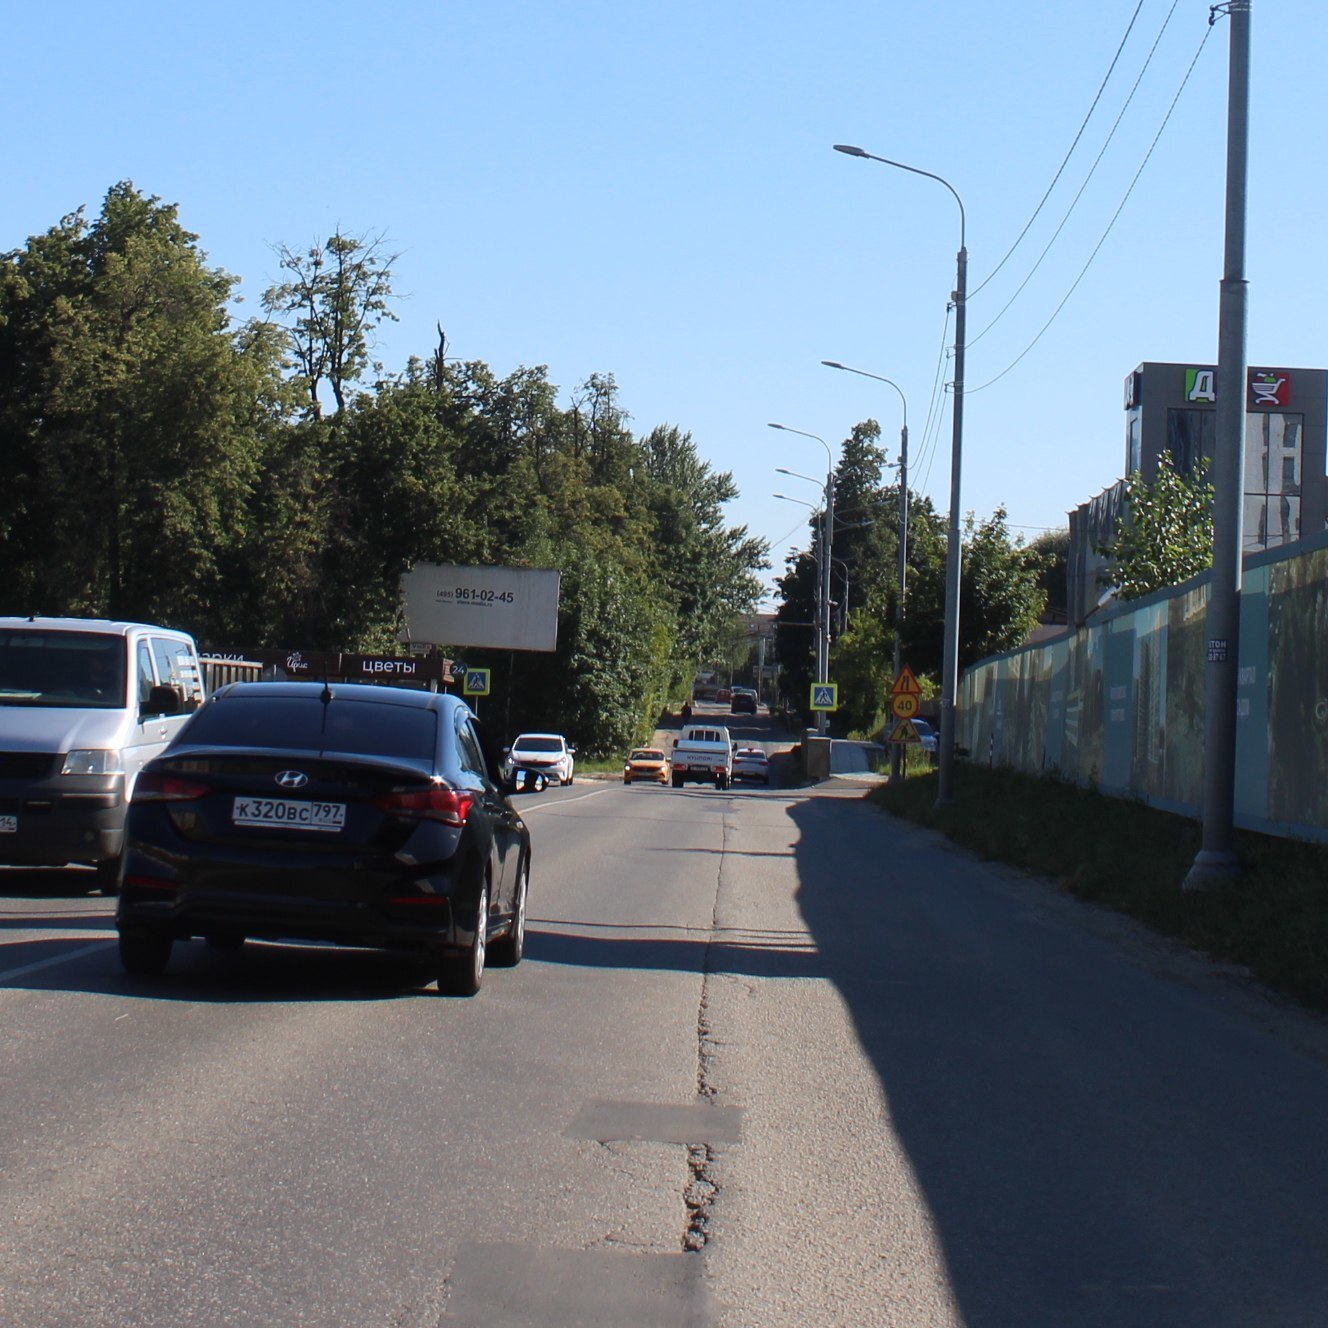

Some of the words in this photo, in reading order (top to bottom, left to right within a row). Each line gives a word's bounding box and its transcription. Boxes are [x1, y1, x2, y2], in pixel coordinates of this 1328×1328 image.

[455, 587, 514, 603] 961-02-45
[362, 659, 416, 674] цветы
[897, 700, 913, 711] 40
[314, 803, 341, 818] 797
